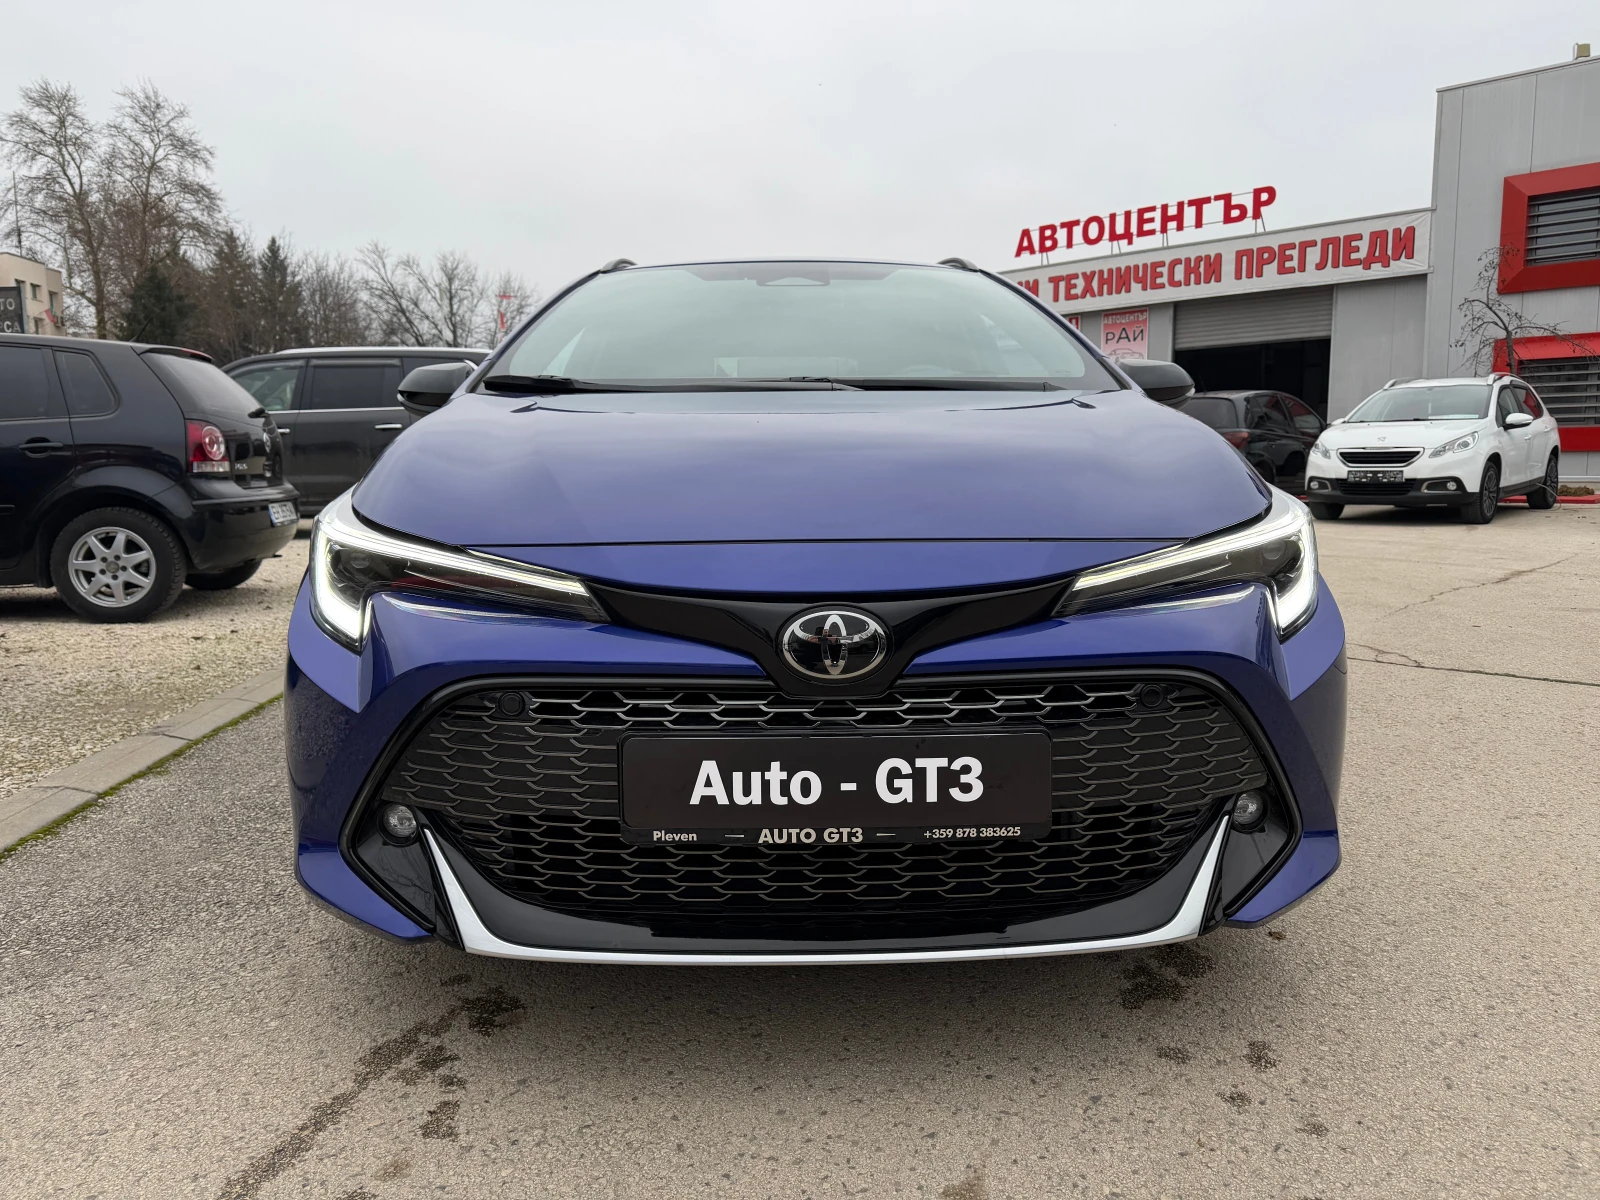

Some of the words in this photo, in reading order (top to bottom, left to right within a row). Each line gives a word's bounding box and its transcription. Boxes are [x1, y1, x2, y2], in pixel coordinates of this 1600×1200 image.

[1015, 185, 1277, 258] АВТОЦЕНТЪР
[1048, 248, 1222, 303] ТЕХНИЧЕСКИ
[1234, 225, 1416, 290] ПРЕГЛЕДИ
[1103, 312, 1147, 325] АВТОЦЕНТЪР
[1105, 325, 1144, 345] РАЙ
[689, 760, 822, 806] Auto
[875, 756, 984, 804] GT3
[653, 830, 697, 842] Pleven
[757, 828, 817, 844] AUTO
[823, 827, 864, 843] GT3
[923, 828, 953, 839] +359
[955, 827, 977, 838] 878
[979, 826, 1021, 837] 383625
